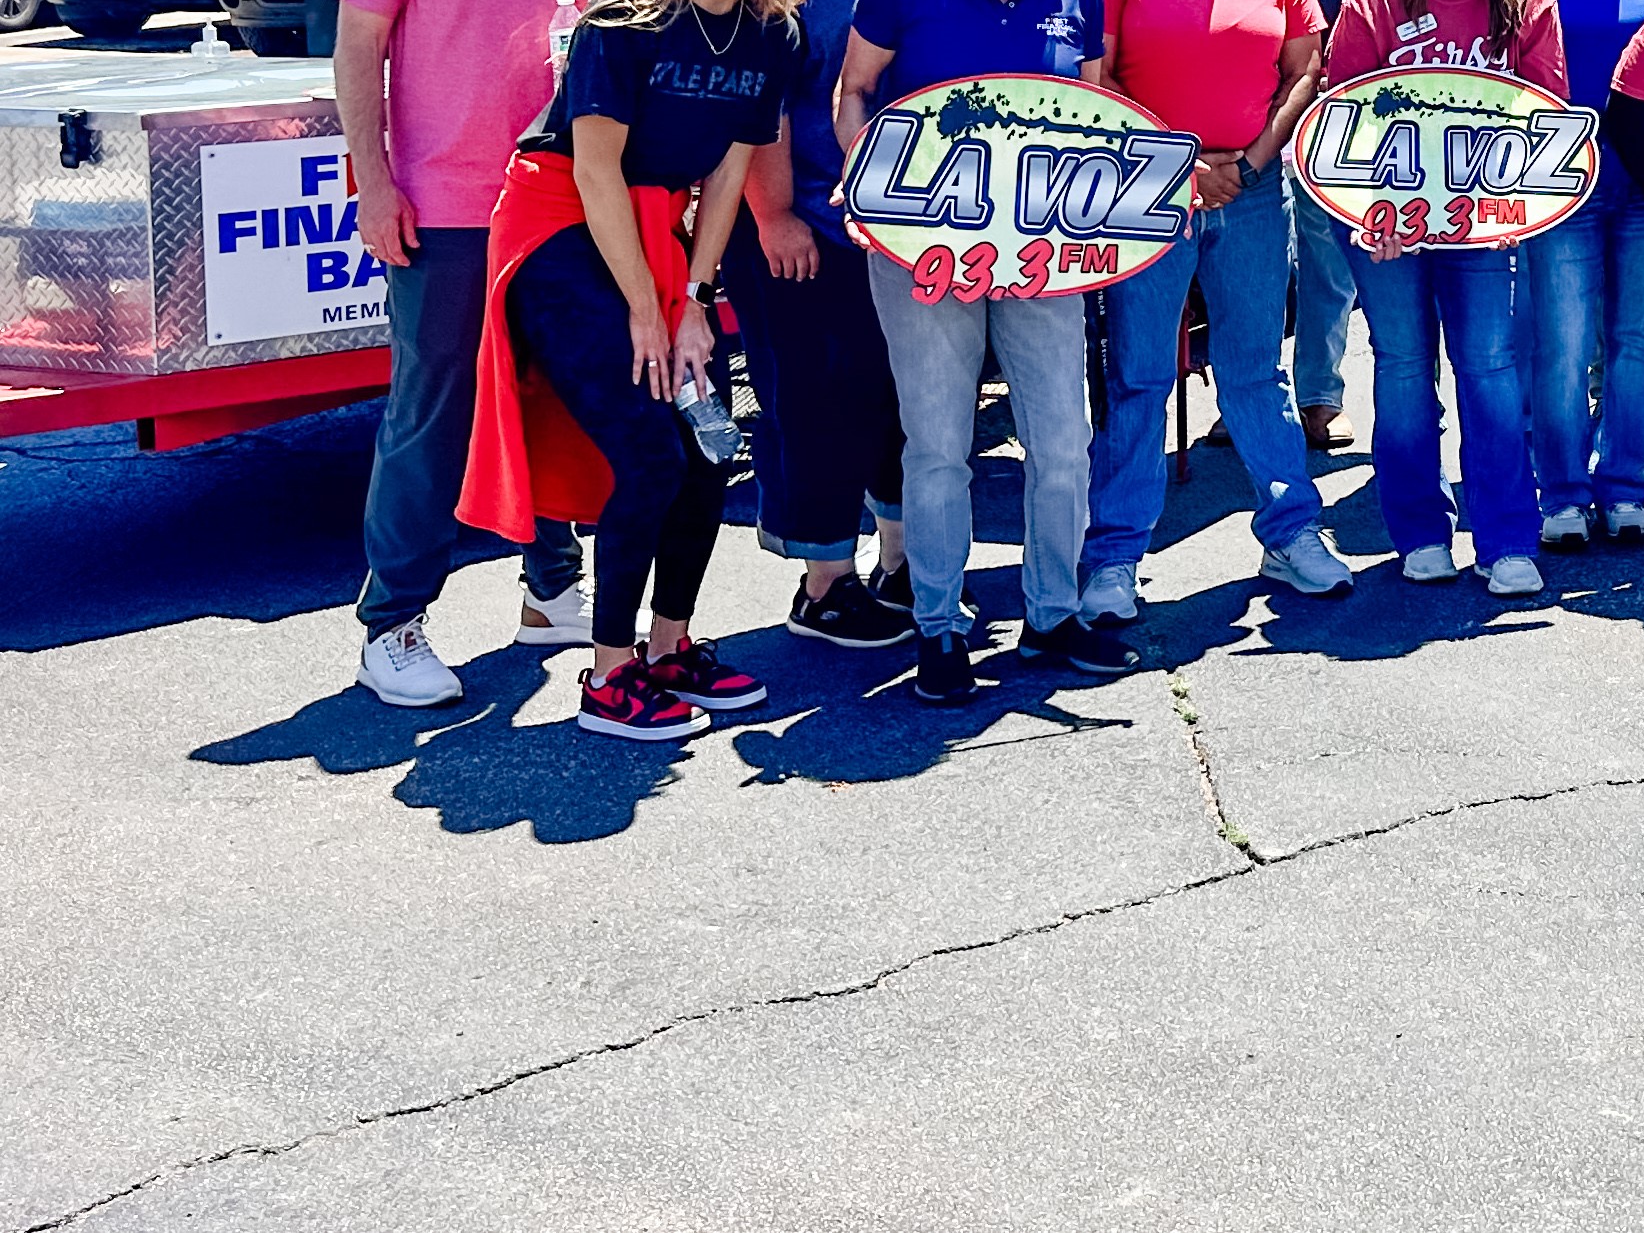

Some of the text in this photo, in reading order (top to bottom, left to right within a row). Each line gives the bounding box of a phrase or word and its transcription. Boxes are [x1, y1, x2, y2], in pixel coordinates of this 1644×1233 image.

[849, 111, 1200, 238] LA VOZ
[1310, 99, 1594, 195] LA VOZ
[1360, 195, 1527, 246] 93.3 FM
[911, 237, 1055, 305] 93.3
[1058, 242, 1119, 274] FM
